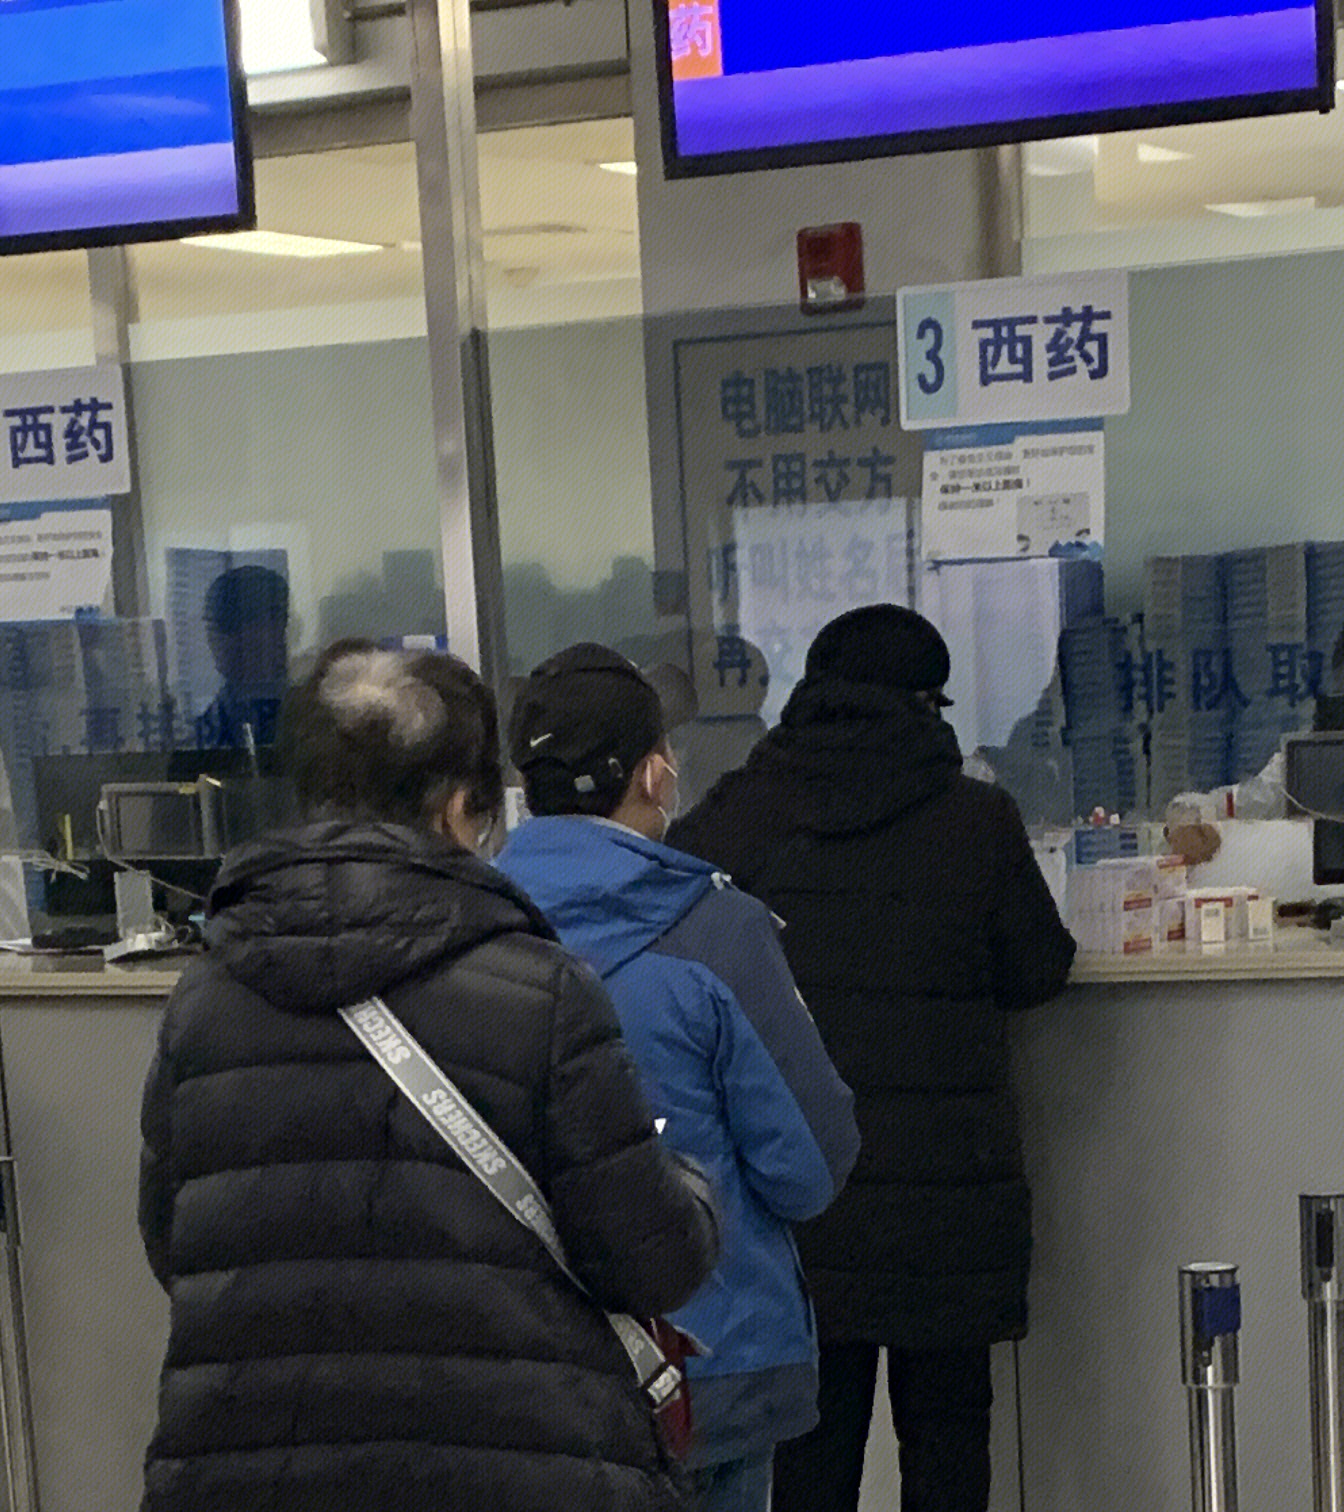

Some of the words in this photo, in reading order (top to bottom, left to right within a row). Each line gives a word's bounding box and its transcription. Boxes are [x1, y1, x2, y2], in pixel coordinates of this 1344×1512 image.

[669, 1, 713, 61] 药
[916, 316, 945, 395] 3
[971, 304, 1112, 387] 西药
[2, 397, 114, 469] 西药
[720, 361, 891, 438] 电脑联网
[422, 1087, 507, 1176] SKECHERS
